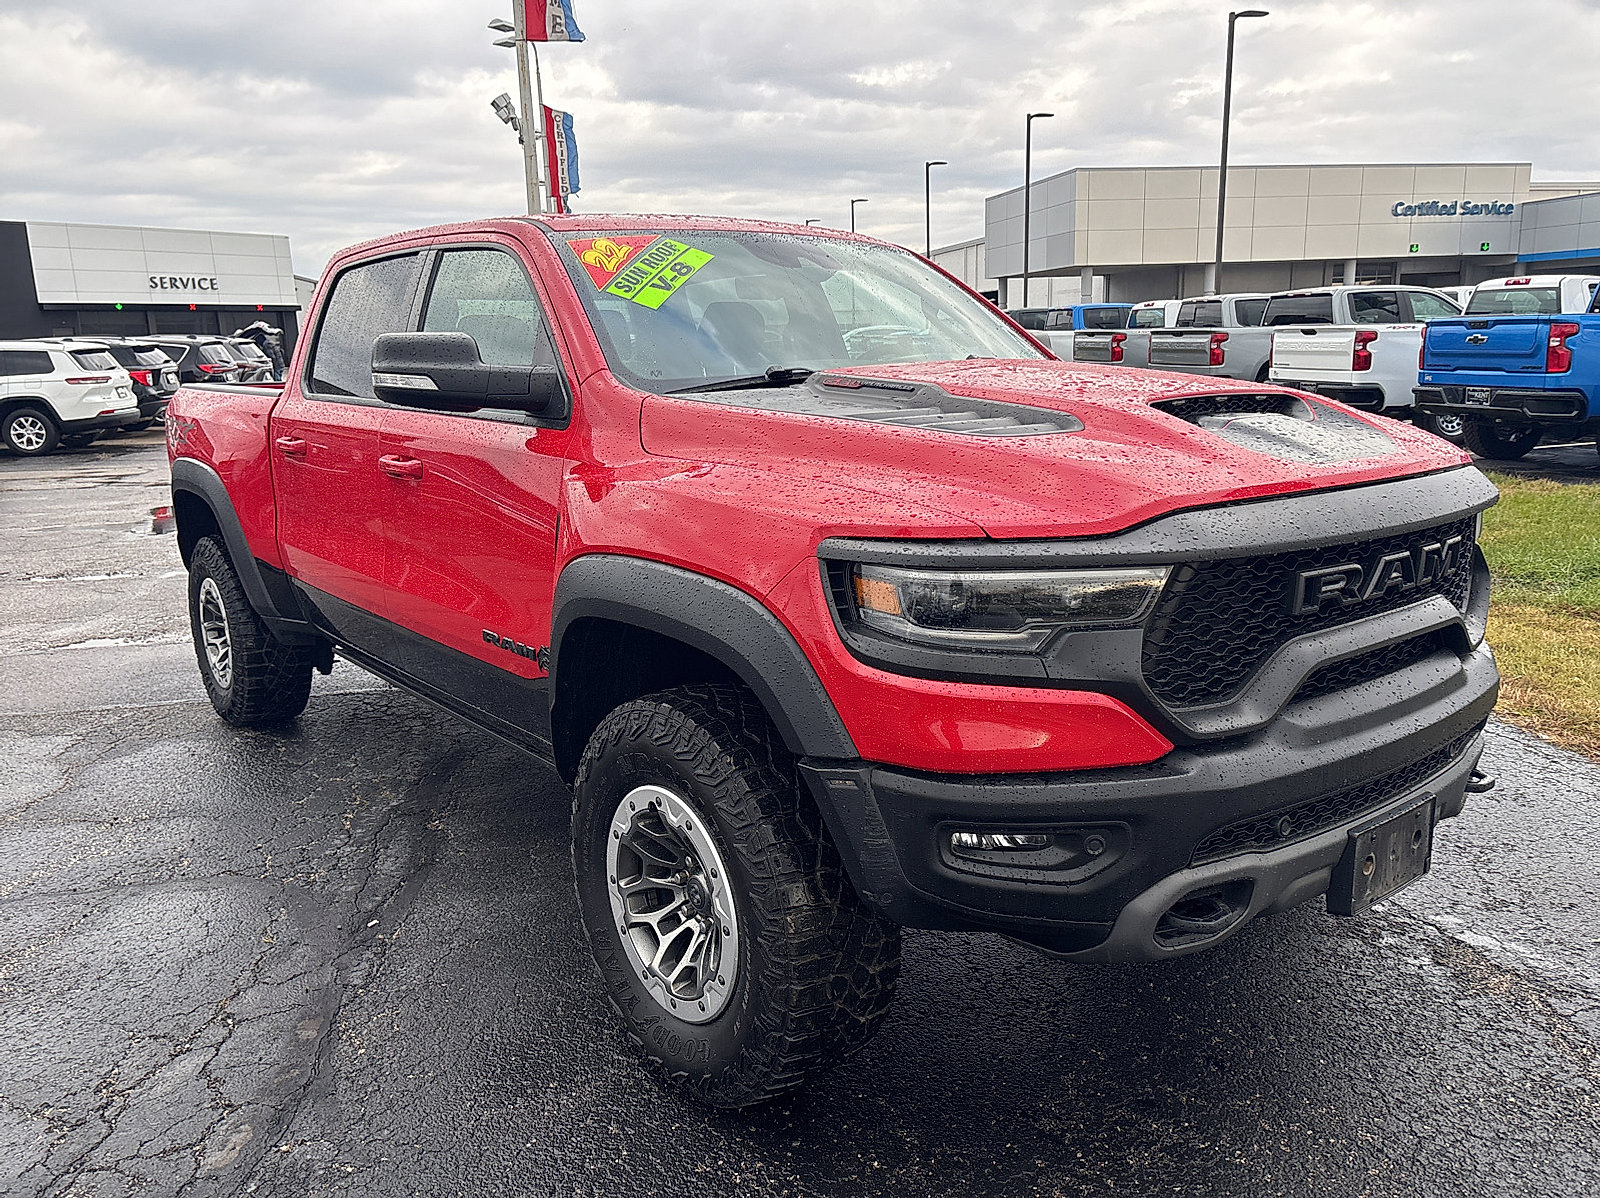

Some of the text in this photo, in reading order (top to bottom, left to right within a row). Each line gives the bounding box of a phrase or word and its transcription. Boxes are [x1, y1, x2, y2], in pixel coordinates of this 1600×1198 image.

[554, 115, 569, 193] CERTIFIED
[1392, 201, 1514, 217] Certified Service
[581, 238, 634, 272] 22
[614, 241, 680, 294] SUN ROOF
[149, 276, 219, 290] SERVICE
[651, 261, 695, 292] V-8
[1293, 535, 1462, 615] RAM
[482, 628, 537, 662] RAM
[594, 928, 712, 1064] GOODYEAR
